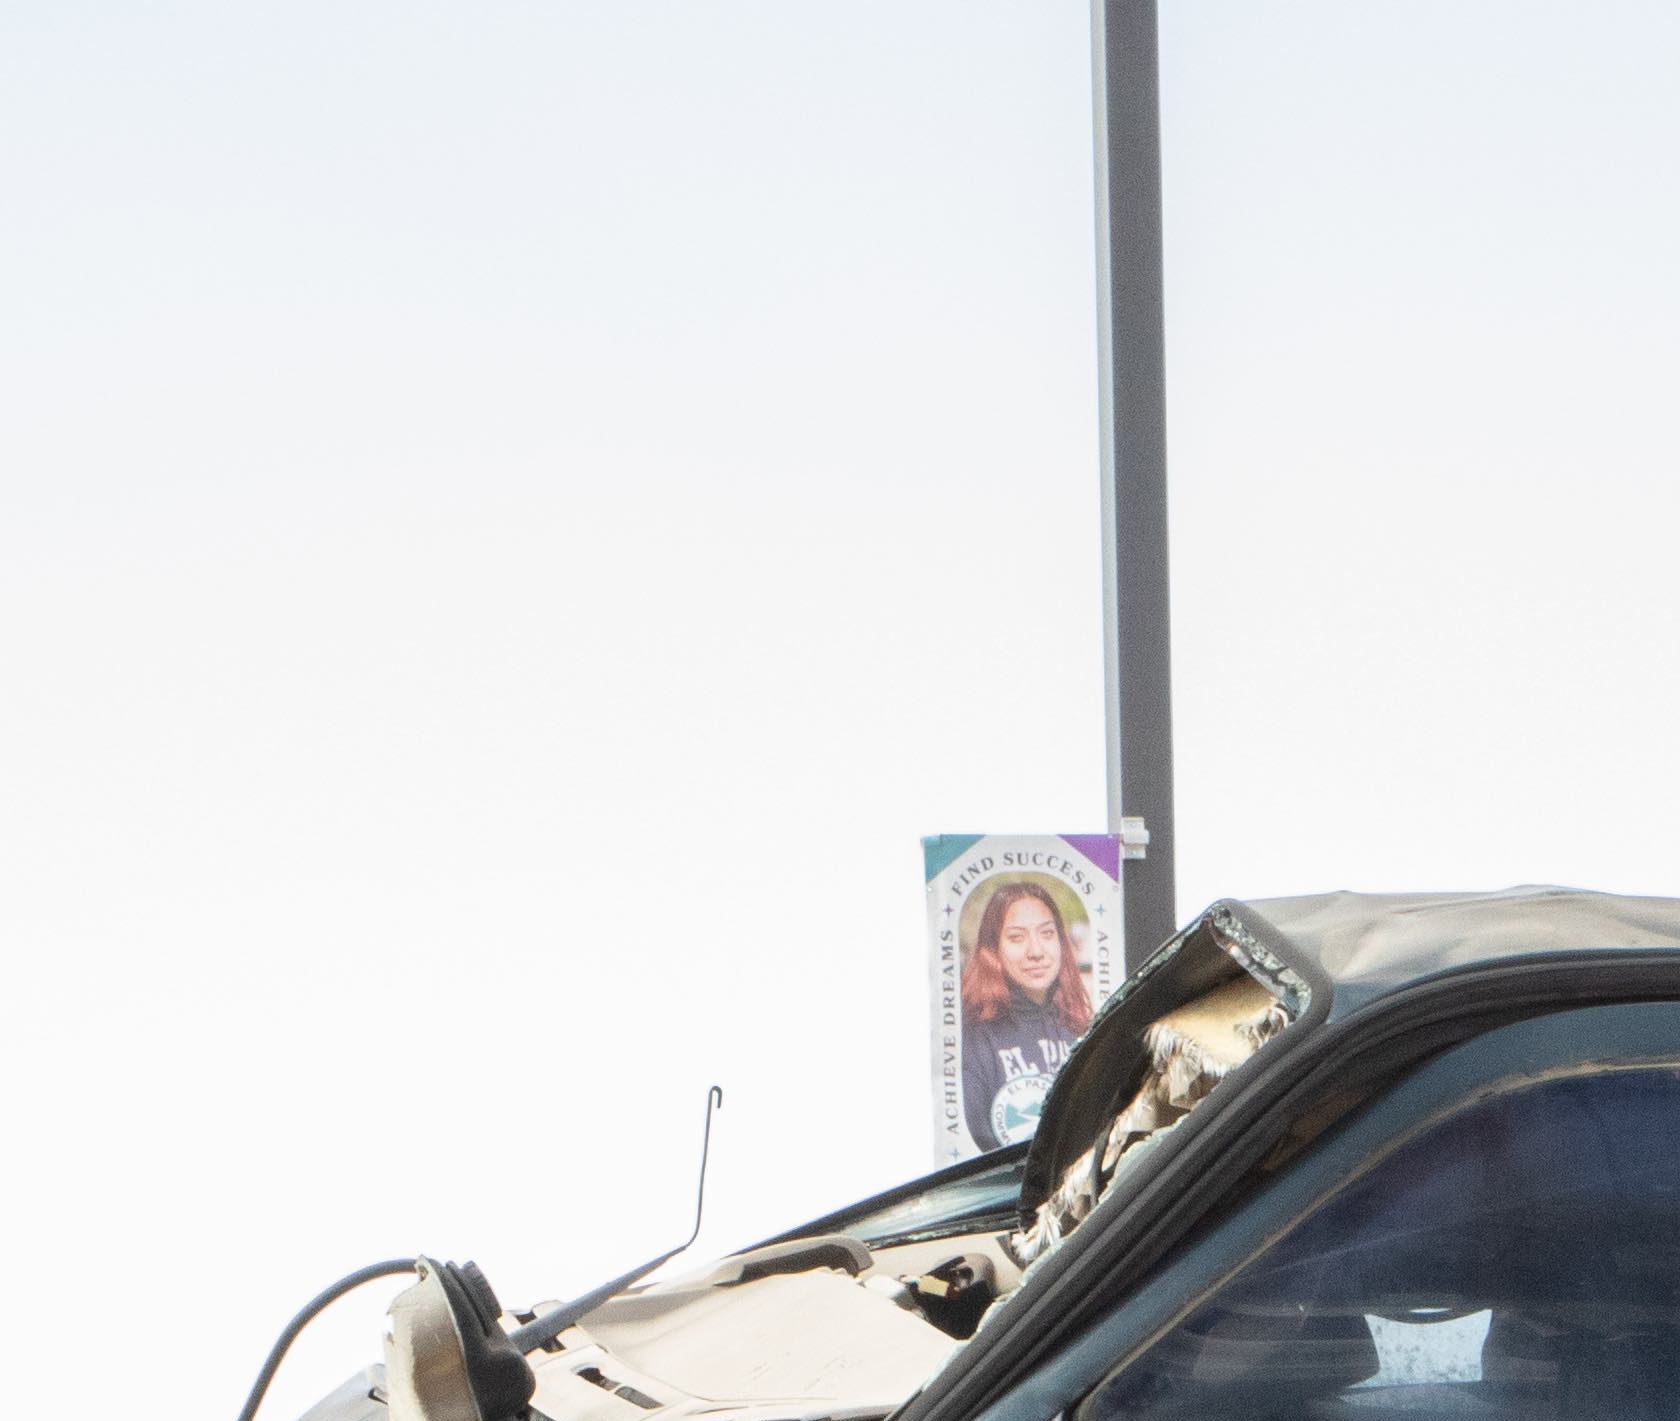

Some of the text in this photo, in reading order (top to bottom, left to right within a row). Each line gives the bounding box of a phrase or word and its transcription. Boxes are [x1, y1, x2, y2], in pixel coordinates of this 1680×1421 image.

[951, 852, 1095, 896] FIND SUCCESS
[940, 929, 959, 1135] ACHIEVE DREAMS
[999, 1047, 1040, 1081] EL
